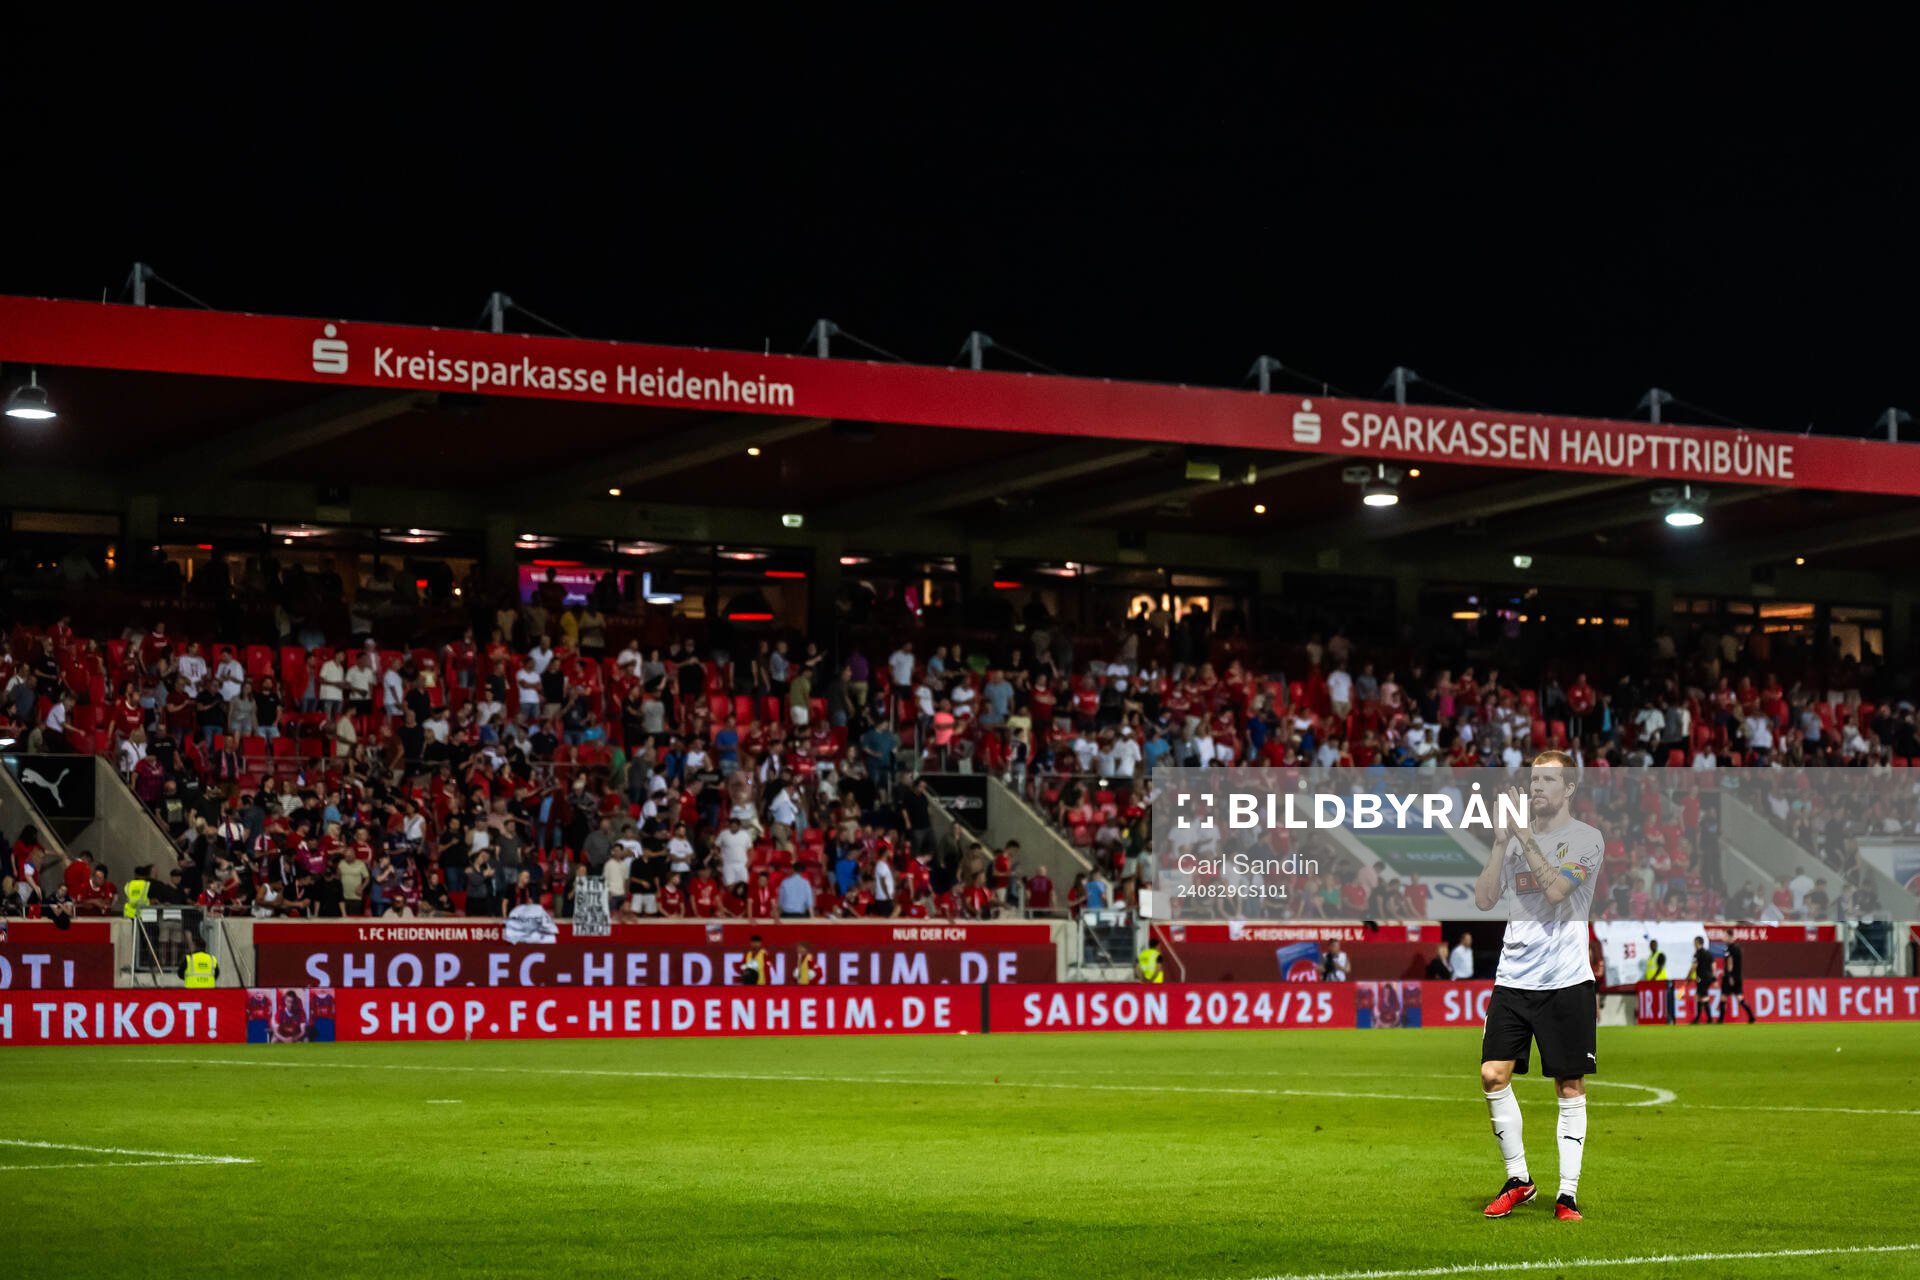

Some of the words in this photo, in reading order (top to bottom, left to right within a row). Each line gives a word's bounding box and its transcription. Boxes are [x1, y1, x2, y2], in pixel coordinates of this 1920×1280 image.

[374, 346, 607, 393] Kreissparkasse
[616, 364, 794, 406] Heidenheim
[1341, 411, 1549, 461] SPARKASSEN
[1561, 428, 1795, 479] HAUPTTRIBÜNE
[359, 927, 368, 941] 1.
[370, 927, 385, 941] FC
[387, 927, 468, 941] HEIDENHEIM
[471, 927, 499, 941] 1846
[892, 927, 918, 941] NUR
[919, 927, 942, 941] DER
[943, 927, 967, 941] FCH
[1253, 928, 1318, 941] HEIDENHEIM
[360, 996, 951, 1035] SHOP.FC-HEIDENHEIM.DE
[1023, 992, 1168, 1027] SAISON
[1185, 991, 1333, 1025] 2024/25
[1754, 986, 1827, 1018] DEIN
[1839, 985, 1894, 1016] FCH
[33, 1002, 218, 1039] TRIKOT!
